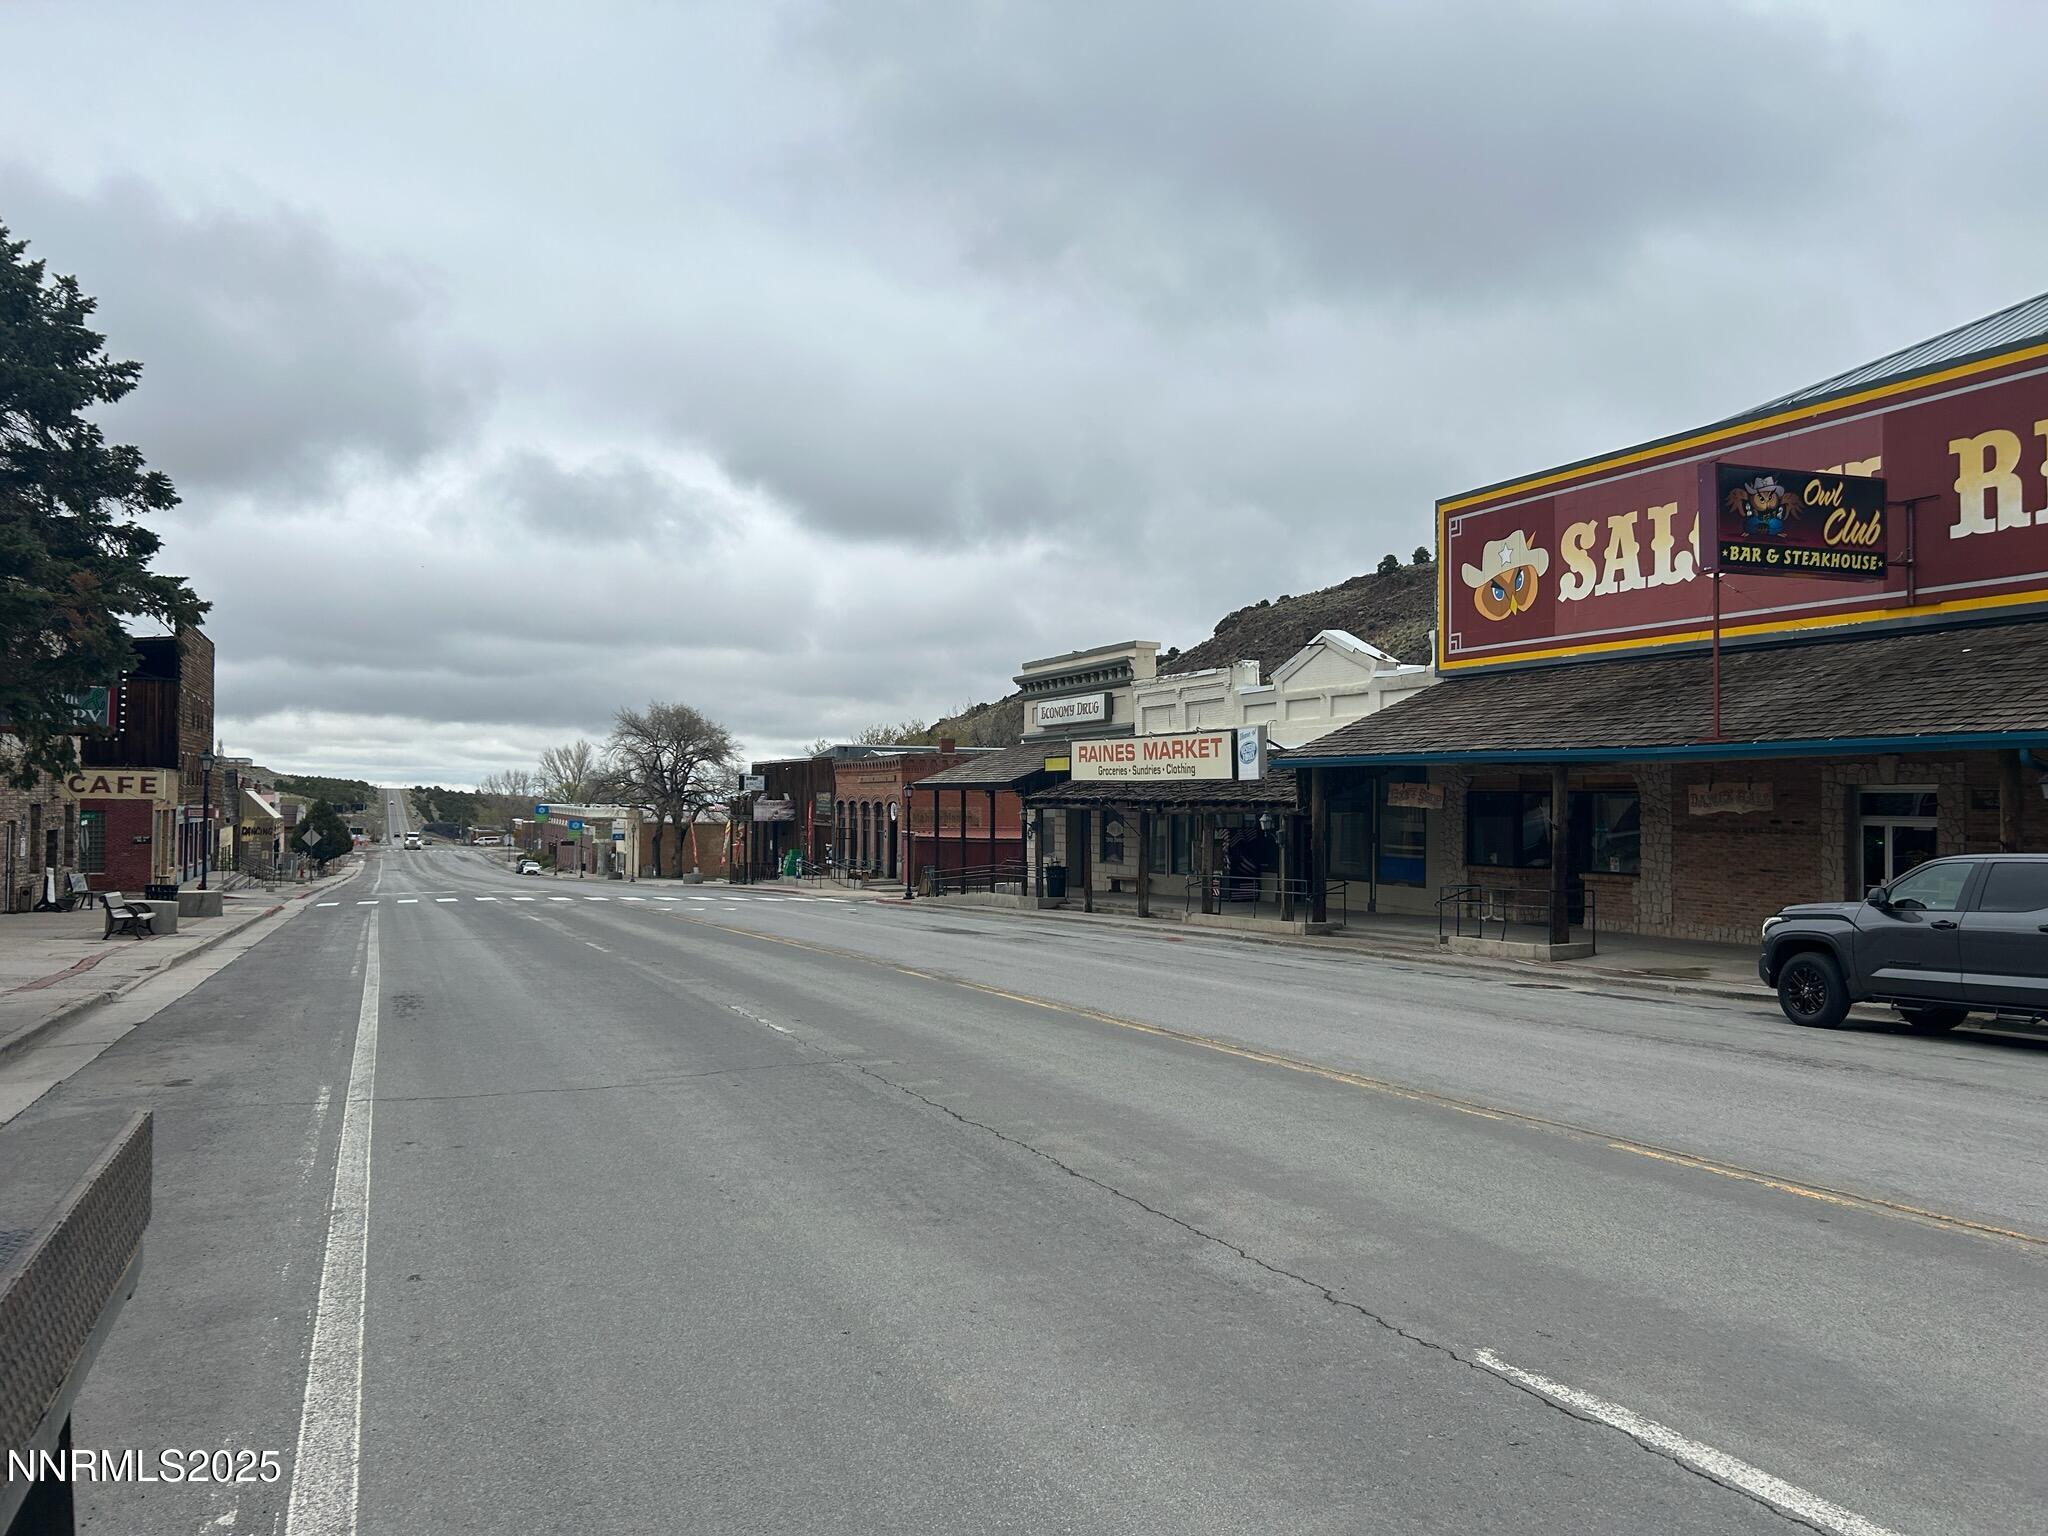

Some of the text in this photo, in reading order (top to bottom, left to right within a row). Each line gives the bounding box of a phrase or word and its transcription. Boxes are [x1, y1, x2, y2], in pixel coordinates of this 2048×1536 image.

[1803, 479, 1843, 508] Owl
[1823, 508, 1881, 547] Club
[1729, 546, 1878, 571] BAR & STEAKHOUSE
[1041, 701, 1099, 720] ECONOMY DRUG
[1078, 743, 1135, 763] RAINES
[1144, 738, 1222, 760] MARKET
[1098, 763, 1196, 777] Groceries Sundries Clothing
[68, 775, 157, 794] CAFE
